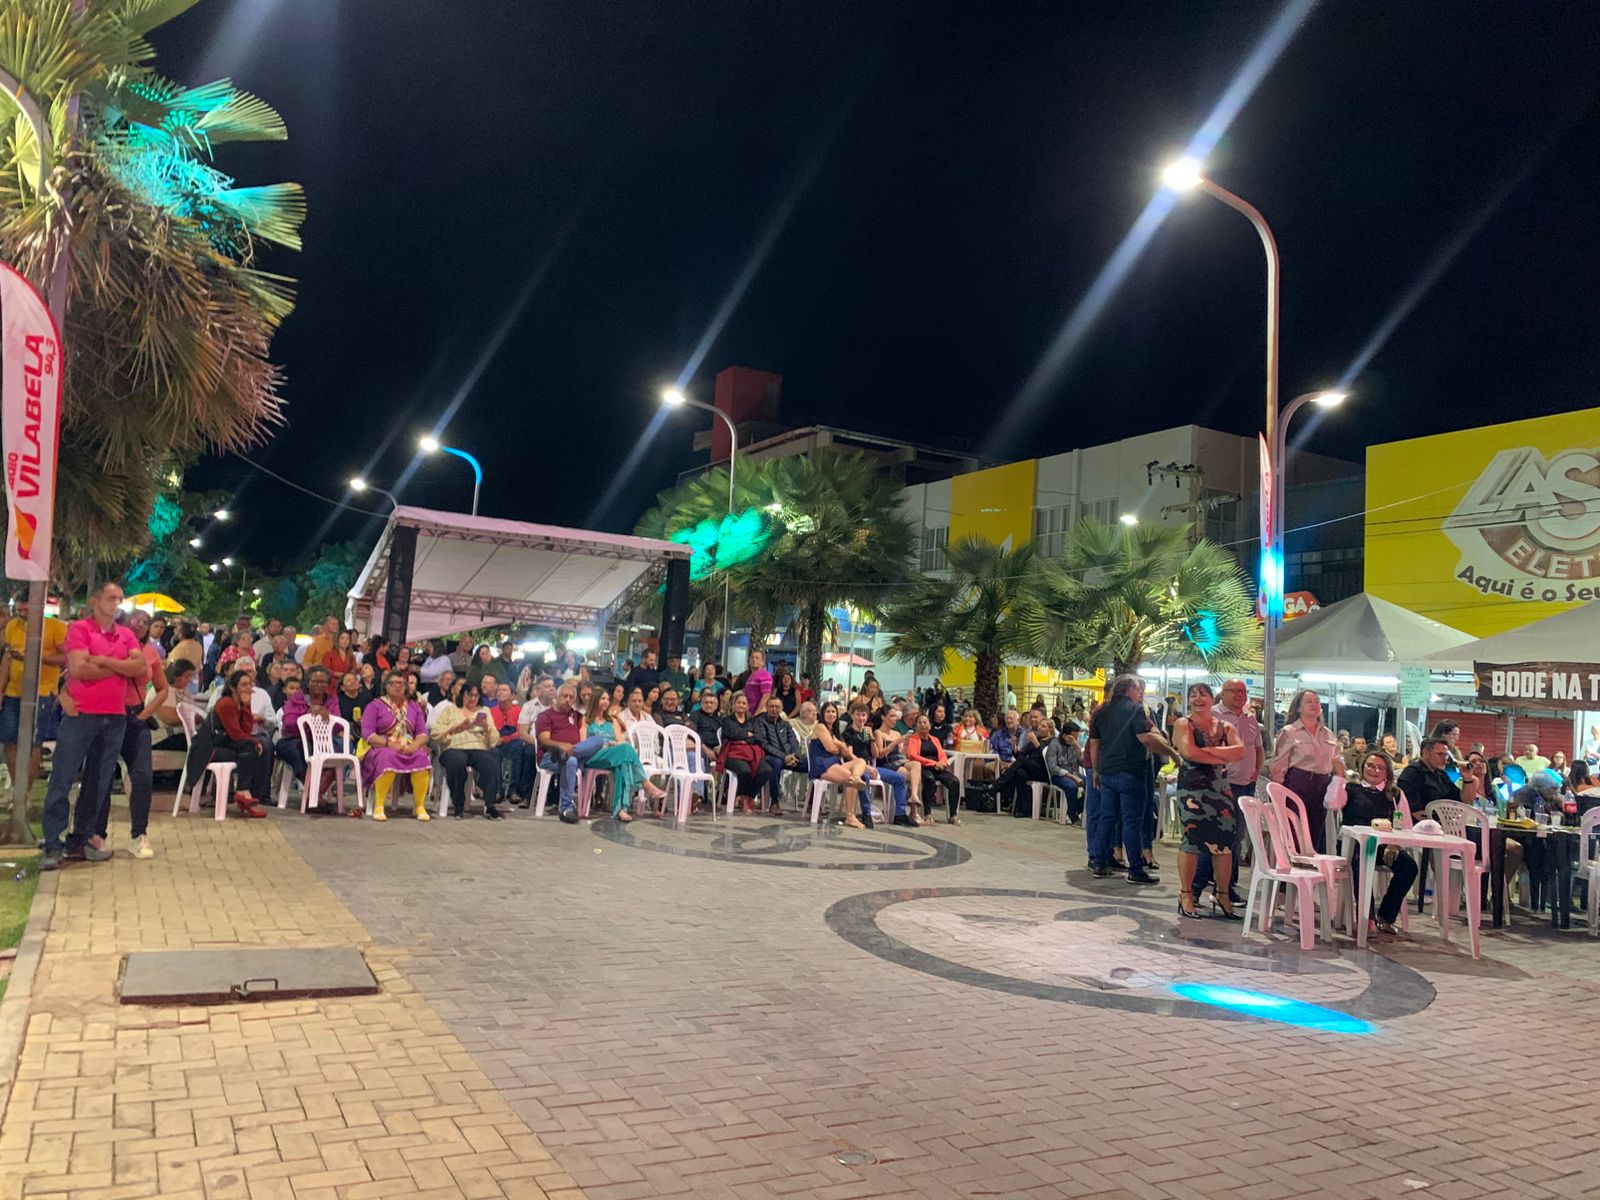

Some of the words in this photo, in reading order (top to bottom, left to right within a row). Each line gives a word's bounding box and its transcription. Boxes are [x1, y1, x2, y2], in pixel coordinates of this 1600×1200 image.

[16, 335, 44, 498] VILABELA
[7, 453, 19, 491] ADIO
[1504, 537, 1600, 578] ELET
[1457, 565, 1515, 594] Aqui
[1520, 582, 1535, 600] é
[1541, 588, 1558, 602] o
[1491, 671, 1547, 698] BODE
[1552, 672, 1583, 700] NA
